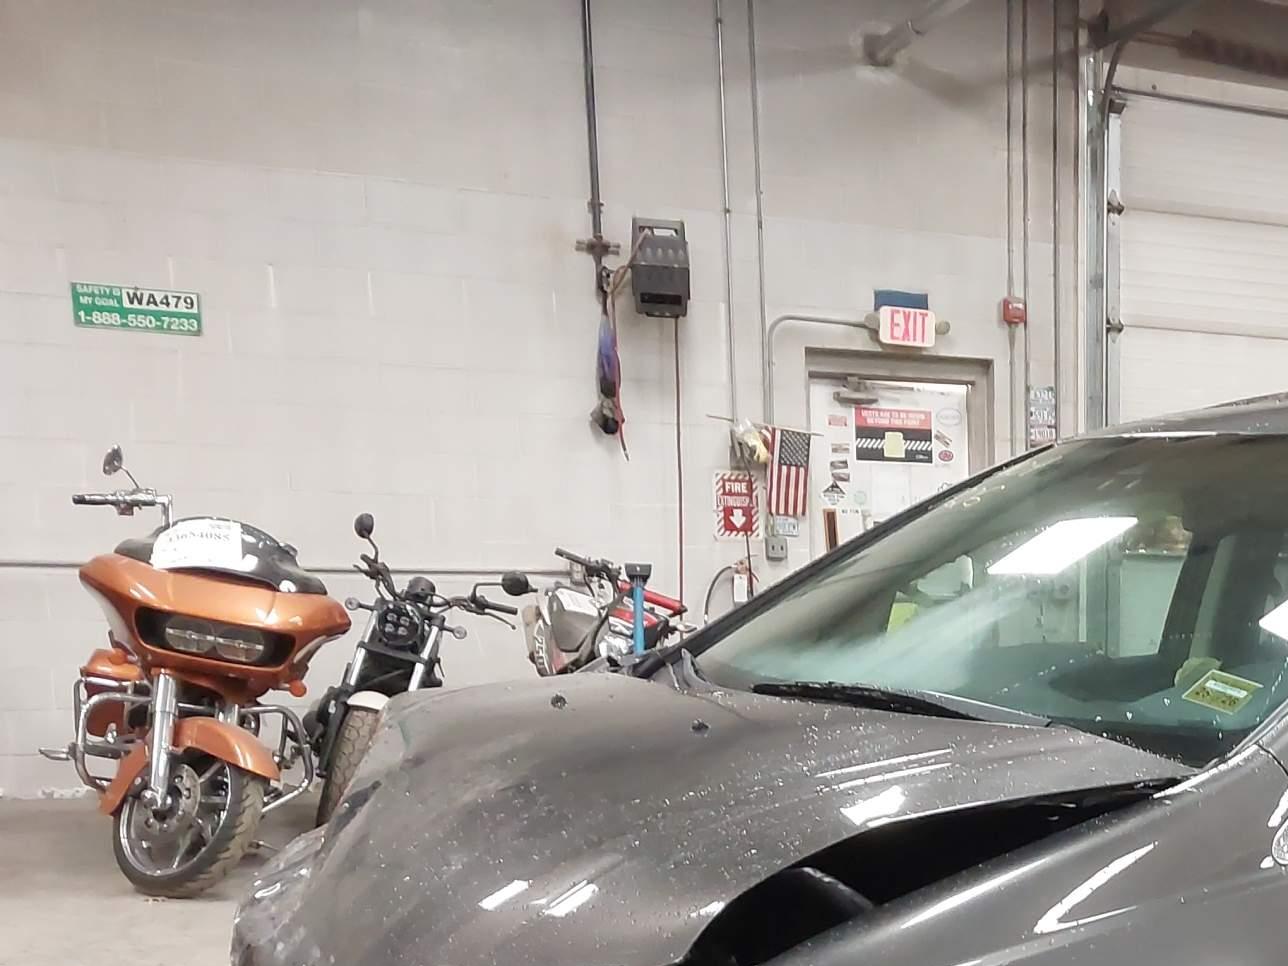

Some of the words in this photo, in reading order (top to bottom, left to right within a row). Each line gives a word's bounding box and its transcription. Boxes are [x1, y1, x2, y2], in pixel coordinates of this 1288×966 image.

[76, 284, 110, 295] SAFETY
[79, 295, 93, 305] MY
[126, 291, 195, 310] WA479
[78, 310, 198, 331] 1-888-550-7233
[889, 309, 929, 344] EXIT
[725, 481, 748, 494] FIRE
